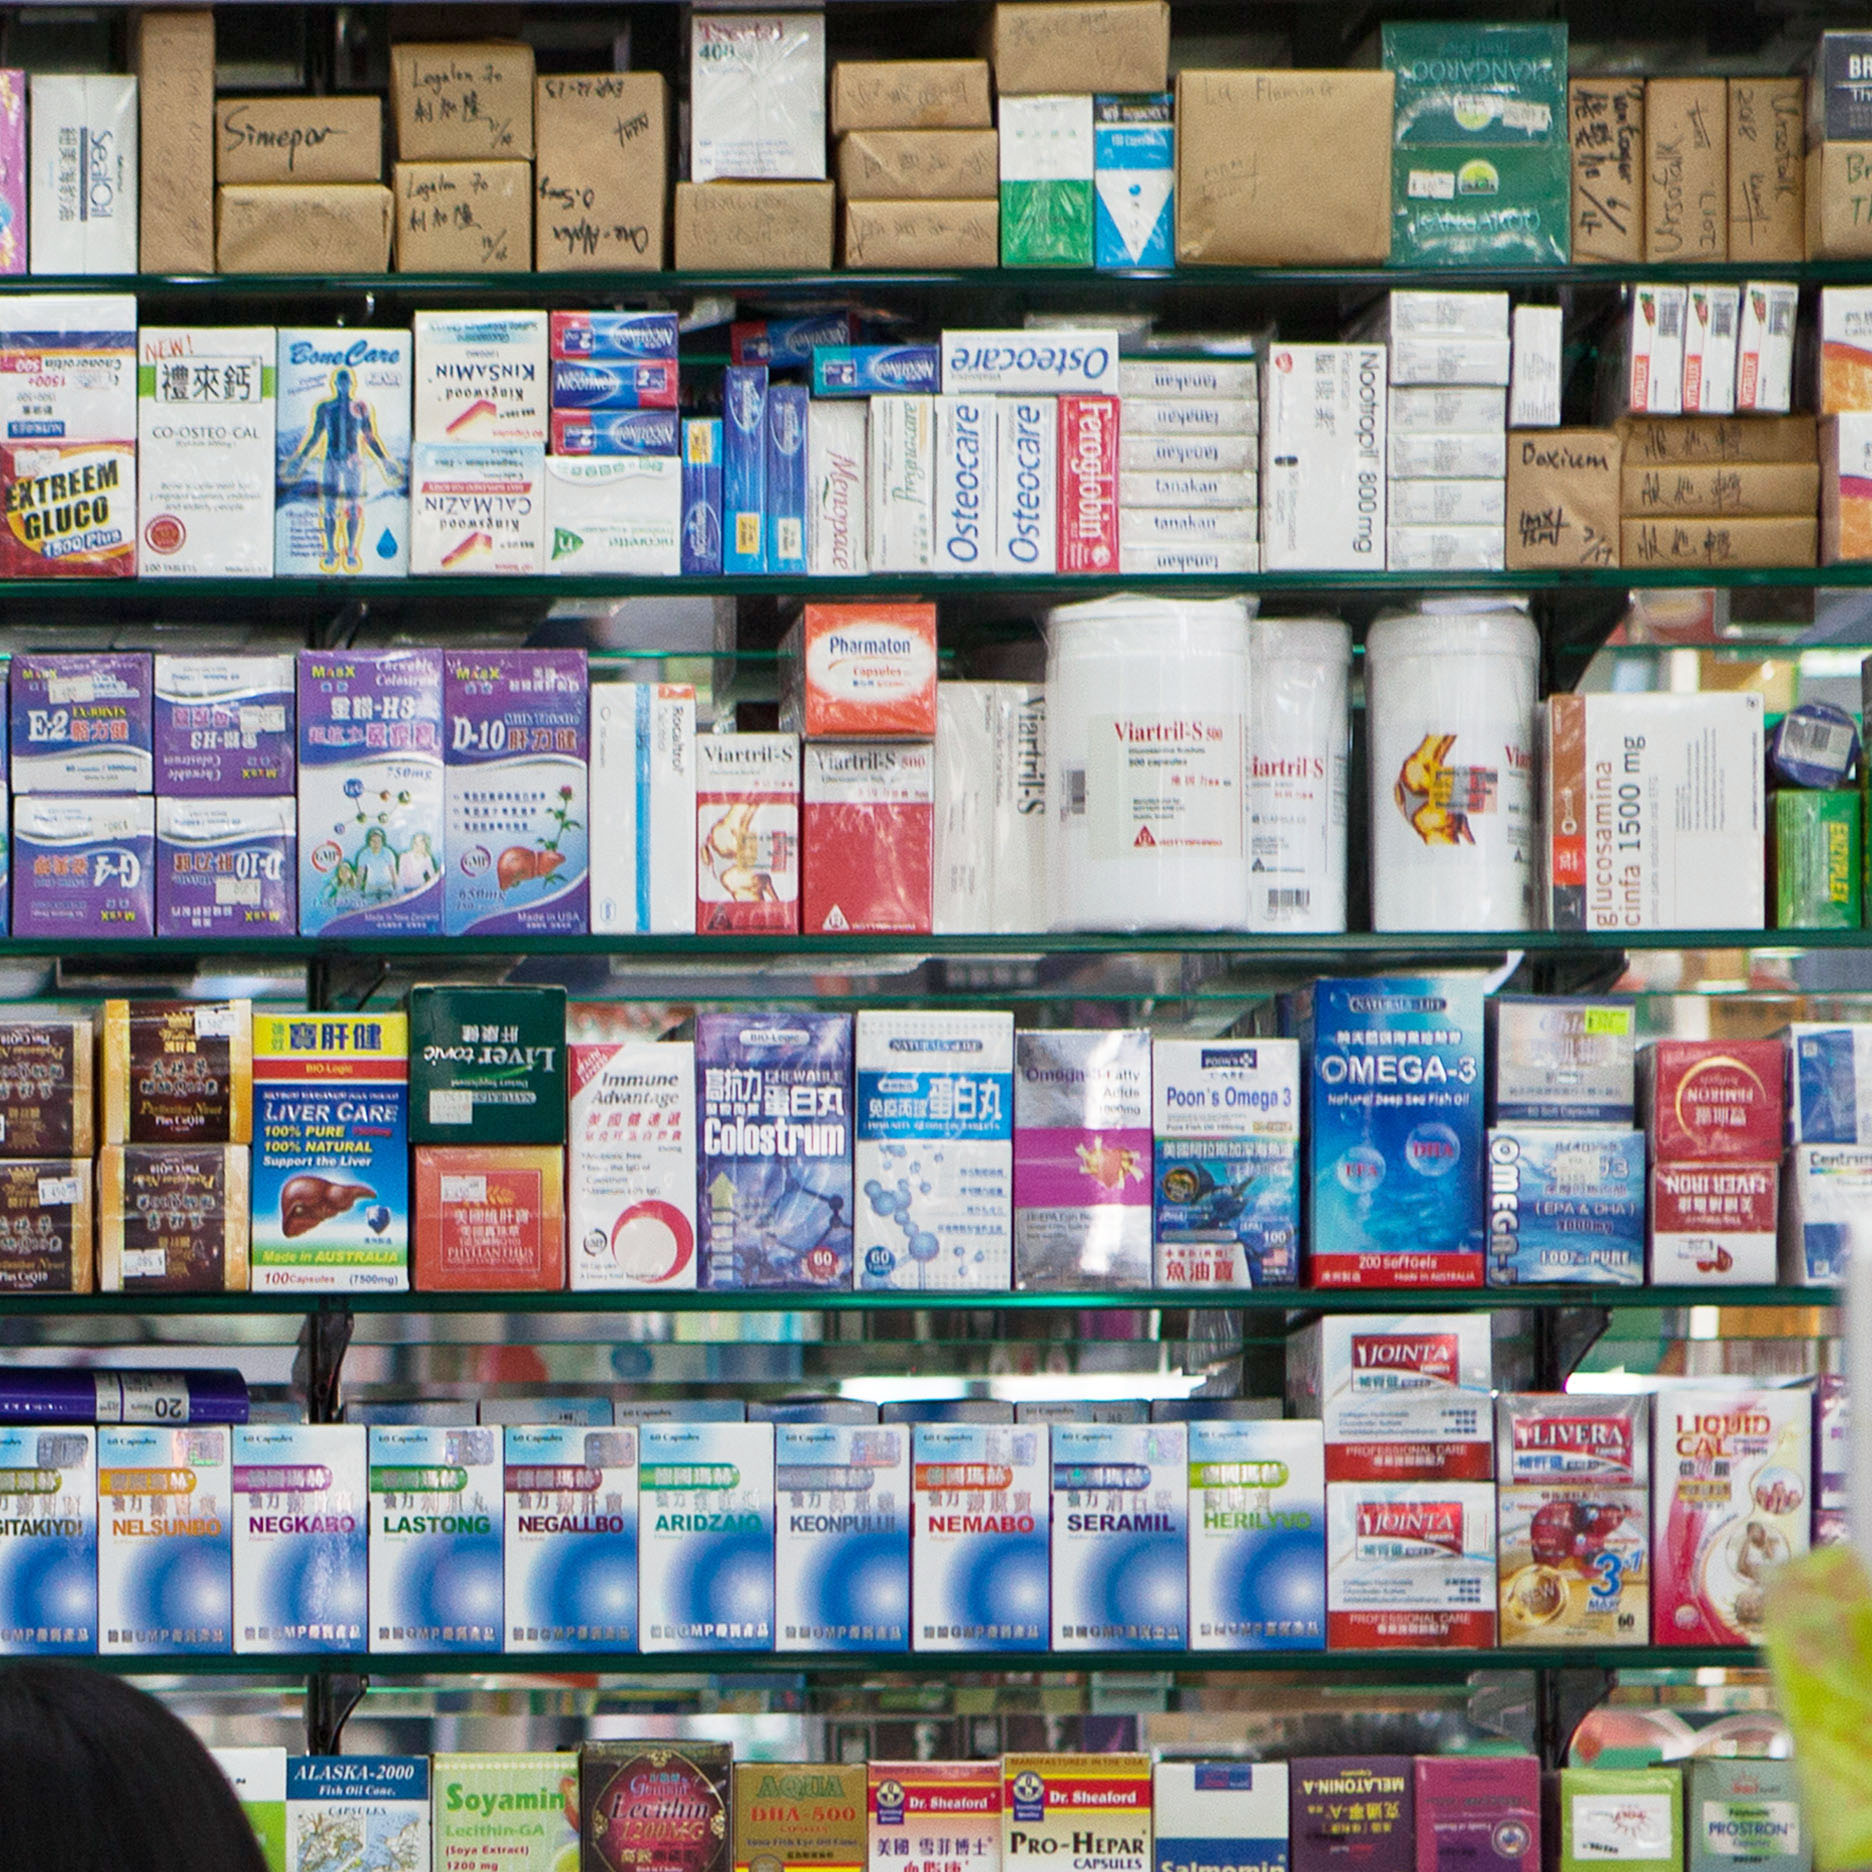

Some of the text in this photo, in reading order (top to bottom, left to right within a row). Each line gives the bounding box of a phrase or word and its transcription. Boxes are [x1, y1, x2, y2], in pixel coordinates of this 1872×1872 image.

[146, 336, 197, 362] NEW!
[1356, 351, 1380, 458] Nootropil
[1078, 399, 1111, 540] Feroglobin
[956, 404, 981, 563] Osteocare
[1008, 405, 1040, 563] Osteocare
[1155, 478, 1219, 497] tanakan
[830, 636, 911, 656] Pharmaton
[1113, 720, 1203, 744] Viartril-S
[1622, 783, 1645, 860] 1500
[1595, 760, 1613, 926] glucosamina
[1622, 866, 1641, 926] cinfa
[425, 1045, 554, 1070] Liver tonic
[602, 1072, 679, 1089] Immune
[1322, 1055, 1477, 1085] OMEGA-3
[1167, 1086, 1292, 1109] Poon's Omega 3
[264, 1103, 398, 1123] LIVER CARE
[704, 1122, 845, 1158] Colostrum
[1366, 1344, 1450, 1363] JOINTA
[1530, 1424, 1622, 1446] LIVERA
[1676, 1414, 1771, 1438] LIQUID
[1676, 1436, 1732, 1457] CAL
[384, 1516, 490, 1535] LASTONG
[928, 1516, 1035, 1533] NEMABO
[295, 1765, 415, 1782] ALASKA-2000
[447, 1783, 565, 1812] Soyamin
[1050, 1791, 1137, 1804] Dr. Sheaford
[1010, 1832, 1144, 1855] PRO-HEPAR
[1074, 1858, 1142, 1869] CAPSULES
